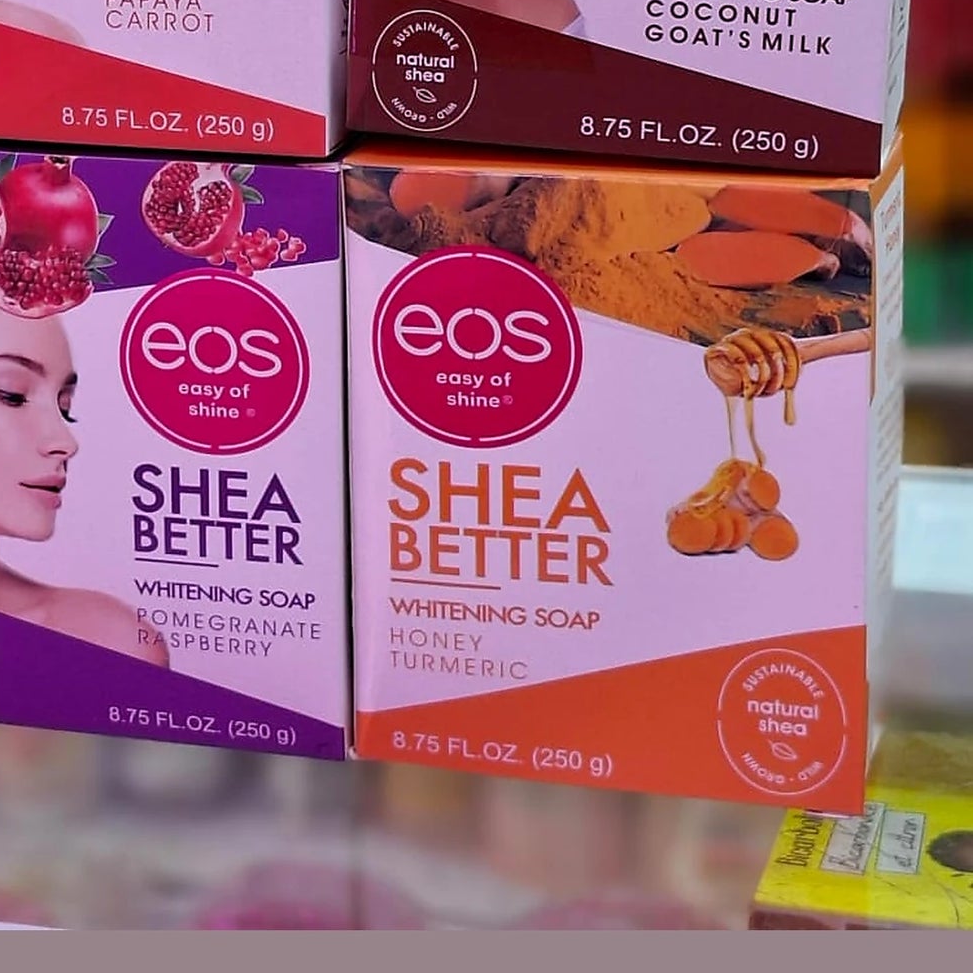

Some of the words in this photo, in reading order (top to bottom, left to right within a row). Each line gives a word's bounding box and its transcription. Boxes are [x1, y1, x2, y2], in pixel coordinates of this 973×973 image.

[106, 10, 214, 33] CARROT
[646, 0, 797, 27] COCONUT
[393, 22, 460, 53] SUSTAINABLE
[761, 32, 832, 56] MILK
[396, 53, 455, 70] natural
[404, 67, 445, 83] shea
[61, 108, 107, 128] 8.75
[114, 109, 189, 132] FL.OZ.
[196, 113, 244, 137] (250
[252, 117, 274, 141] g)
[580, 116, 632, 138] 8.75
[640, 120, 722, 147] FL.OZ.
[731, 127, 787, 154] (250
[795, 132, 820, 159] g)
[394, 303, 551, 364] eos
[142, 322, 282, 379] eos
[178, 382, 224, 399] easy
[230, 382, 250, 398] of
[435, 370, 485, 391] easy
[490, 371, 511, 387] of
[132, 463, 301, 523] SHEA
[387, 457, 610, 533] SHEA
[134, 516, 303, 565] BETTER
[389, 522, 614, 586] BETTER
[134, 580, 252, 606] WHITENING
[259, 590, 315, 610] SOAP
[136, 607, 322, 640] POMEGRANATE
[389, 598, 528, 626] WHITENING
[534, 607, 601, 630] SOAP
[137, 629, 273, 657] RASPBERRY
[389, 628, 482, 652] HONEY
[390, 650, 528, 680] TURMERIC
[742, 661, 823, 699] SUSTAINABLE
[747, 697, 819, 720] natural
[109, 707, 150, 725] 8.75
[156, 710, 222, 734] FL.OZ.
[227, 719, 271, 742] (250
[277, 725, 296, 746] g)
[759, 716, 807, 737] shea
[393, 731, 440, 754] 8.75
[447, 735, 523, 765] FL.OZ.
[532, 746, 583, 771] (250
[589, 754, 613, 778] g)
